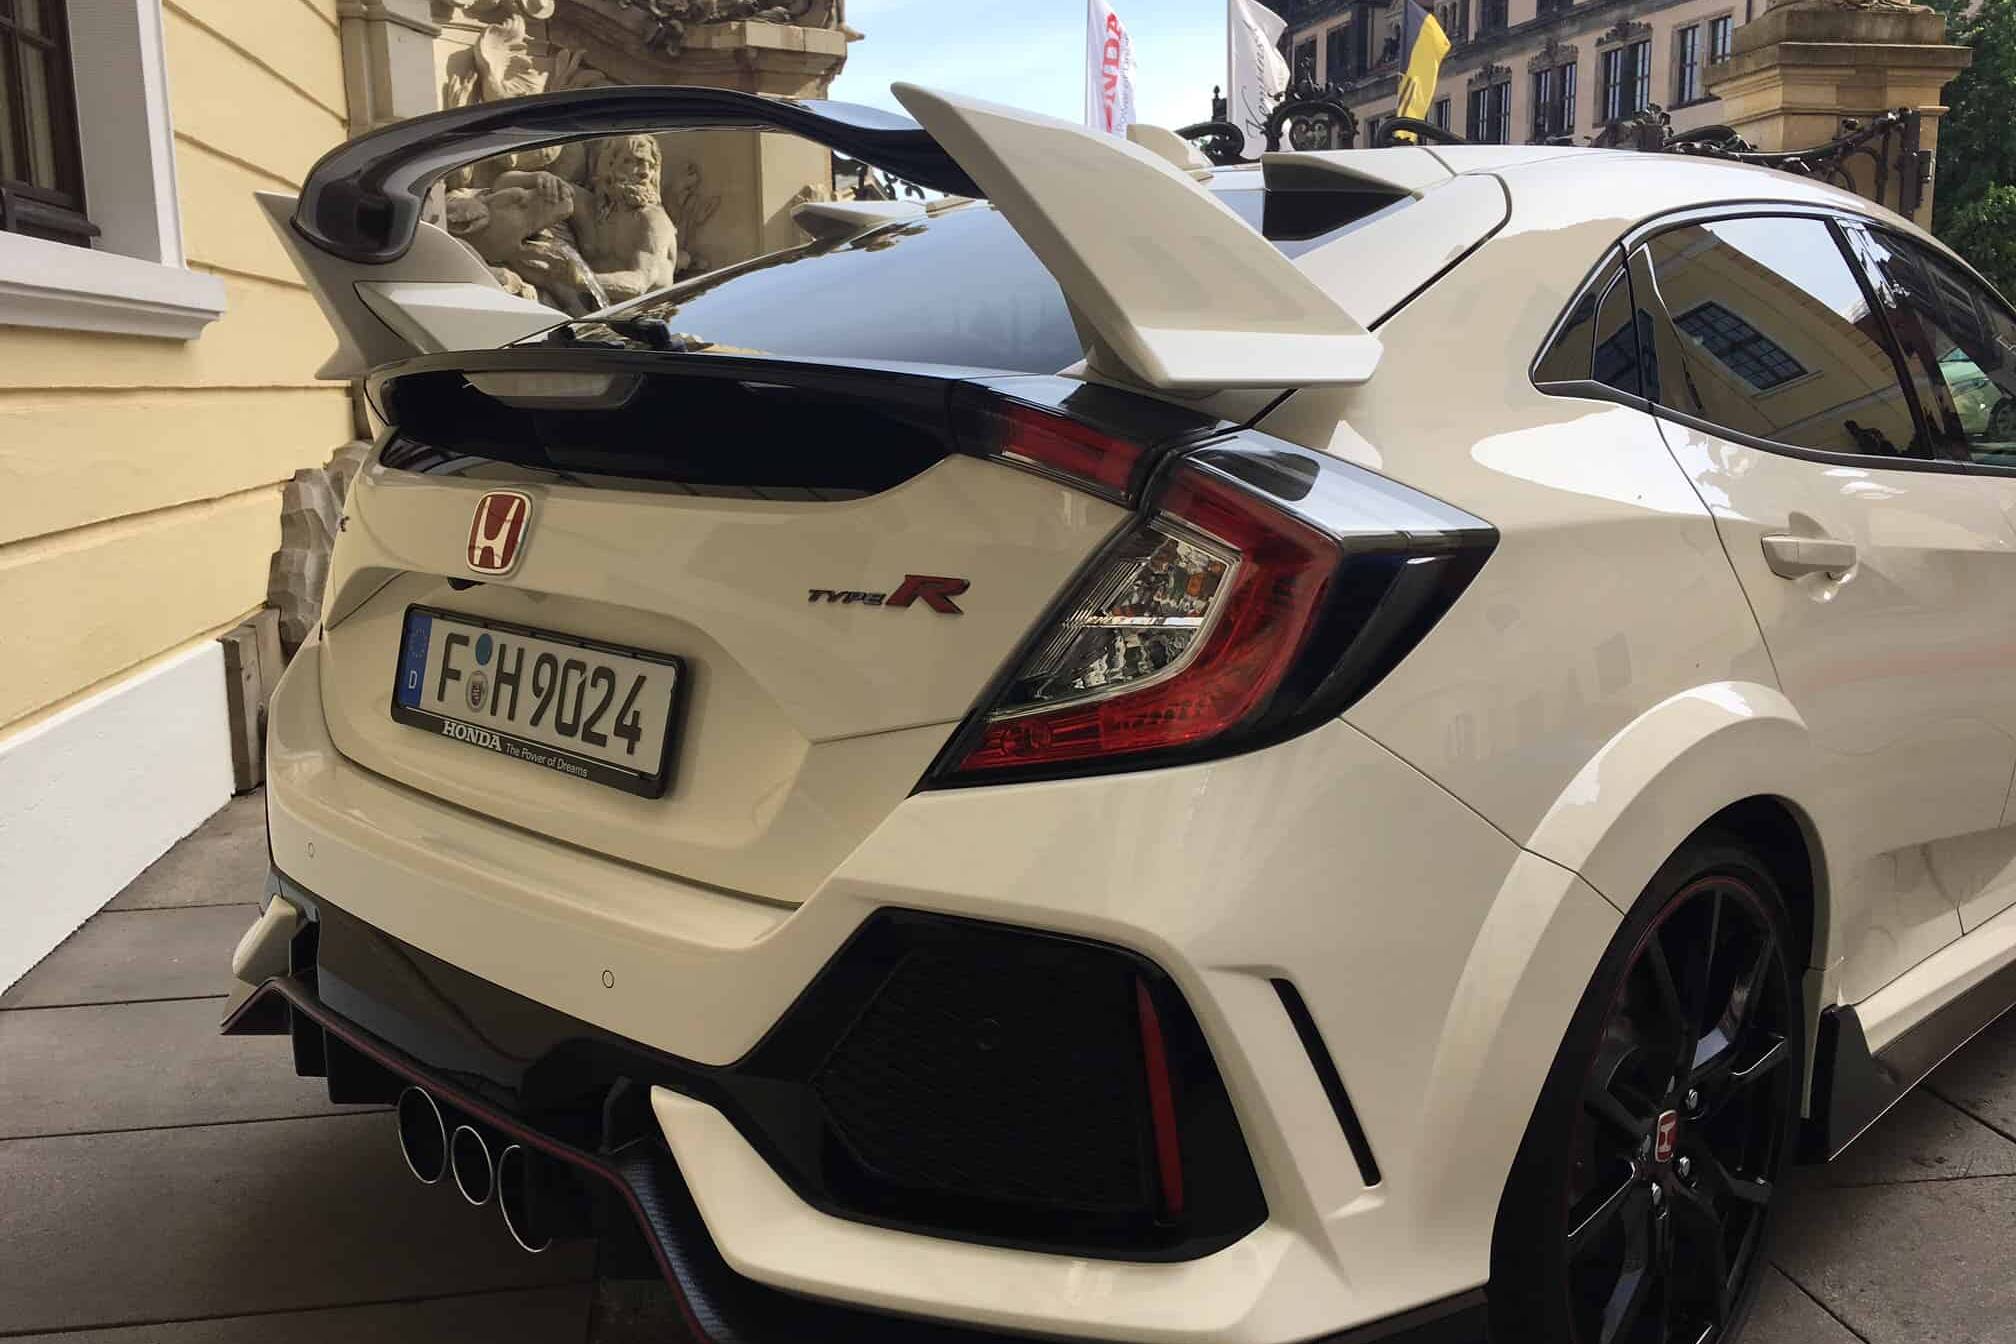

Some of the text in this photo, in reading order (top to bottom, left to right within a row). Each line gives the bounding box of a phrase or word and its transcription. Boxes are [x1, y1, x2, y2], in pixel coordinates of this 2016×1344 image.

[807, 574, 971, 615] TYPE R
[408, 670, 418, 689] D
[442, 720, 588, 778] HONDA The Power of Dreams
